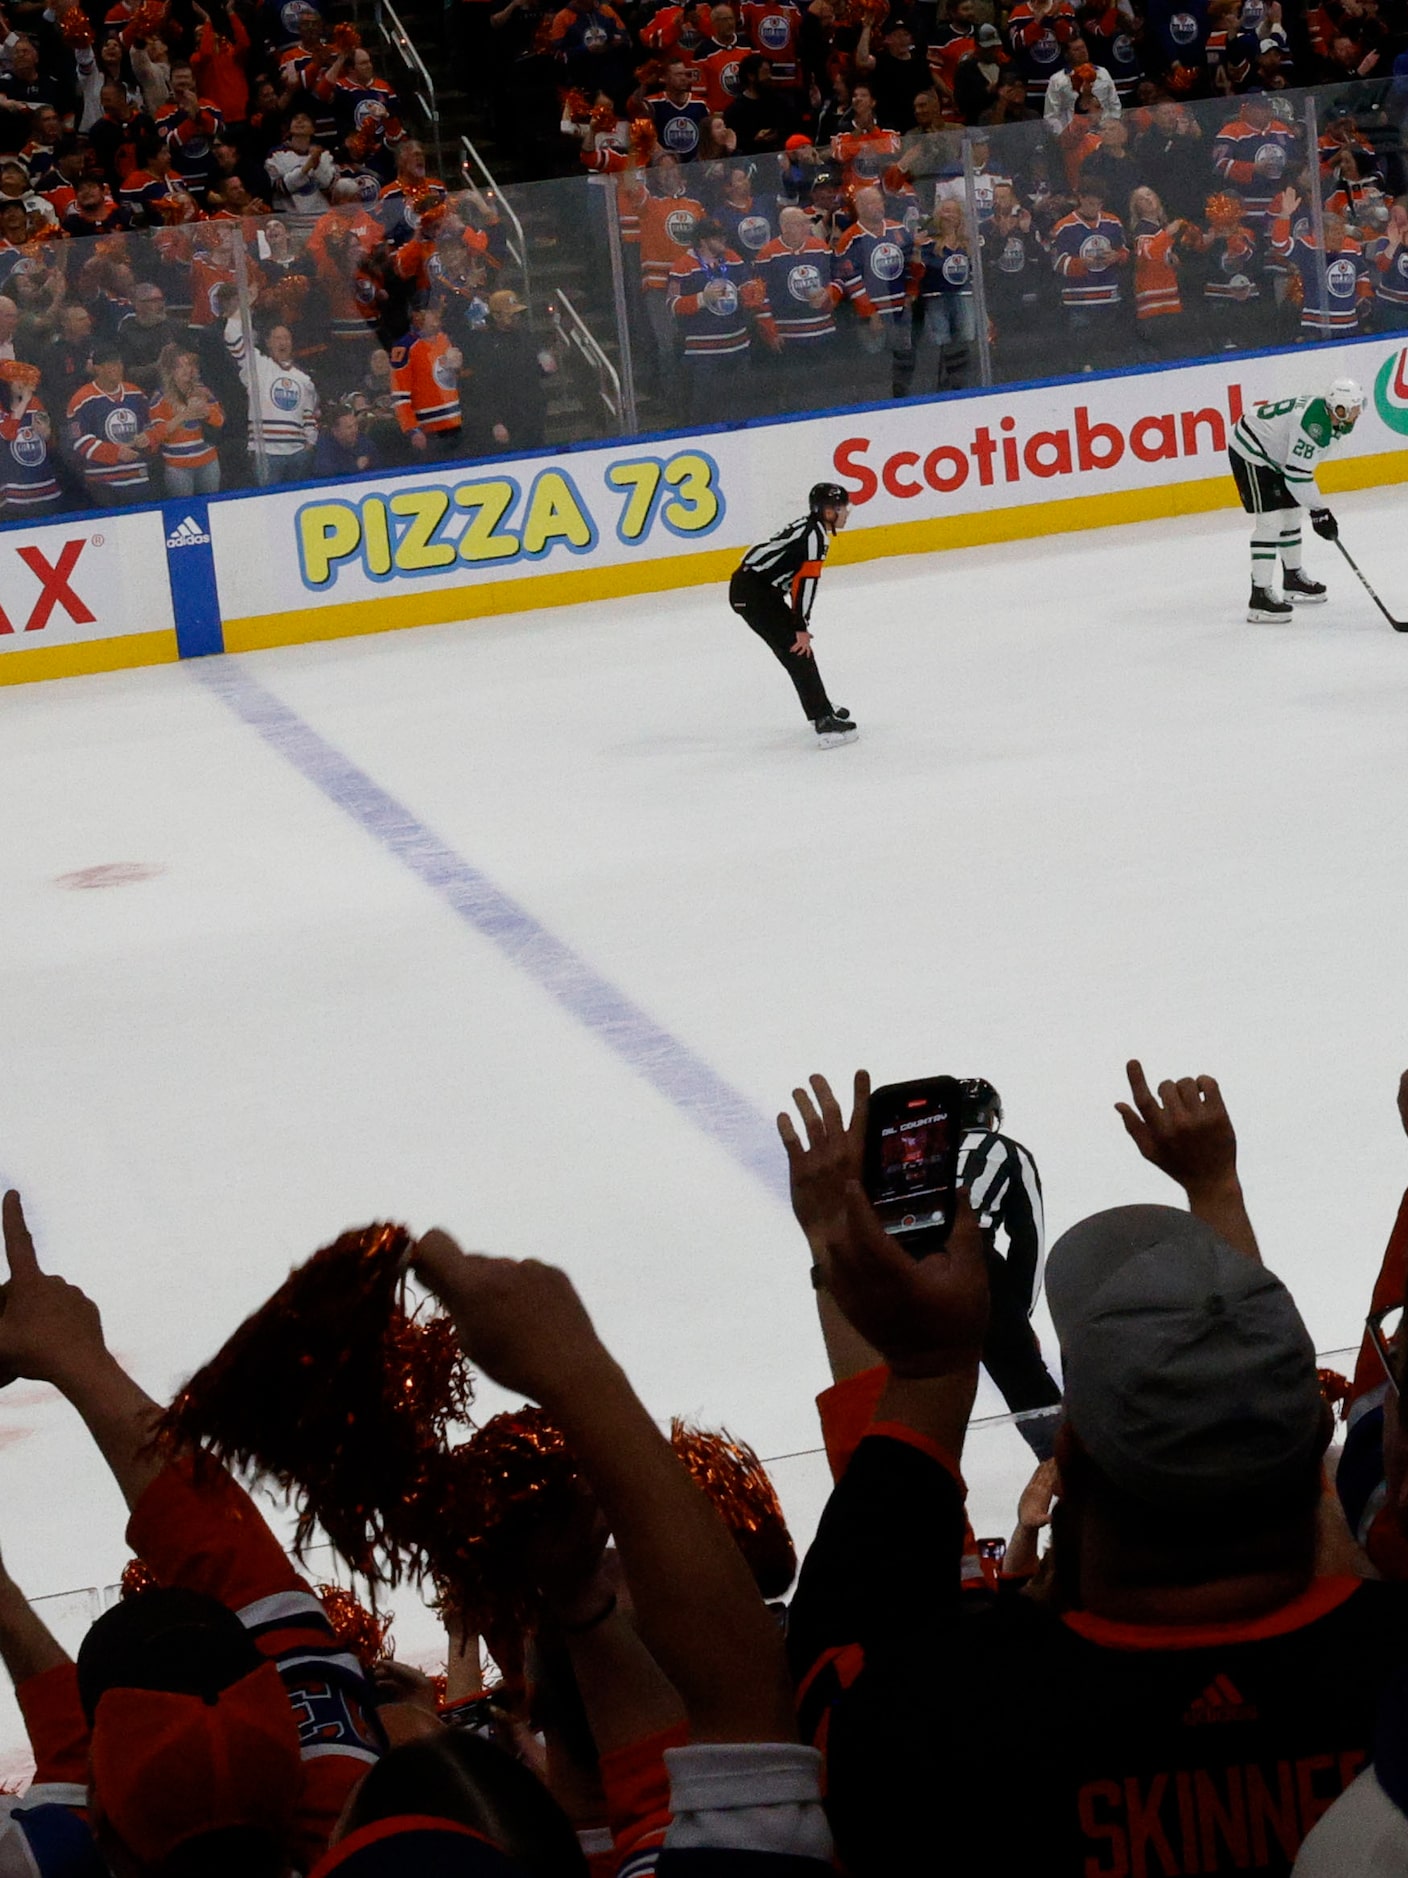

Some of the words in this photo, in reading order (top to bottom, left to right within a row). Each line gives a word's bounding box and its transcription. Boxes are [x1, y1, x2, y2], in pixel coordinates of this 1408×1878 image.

[1292, 438, 1316, 460] 28
[298, 471, 596, 587] PIZZA
[607, 453, 723, 542] 73
[166, 533, 210, 549] adidas
